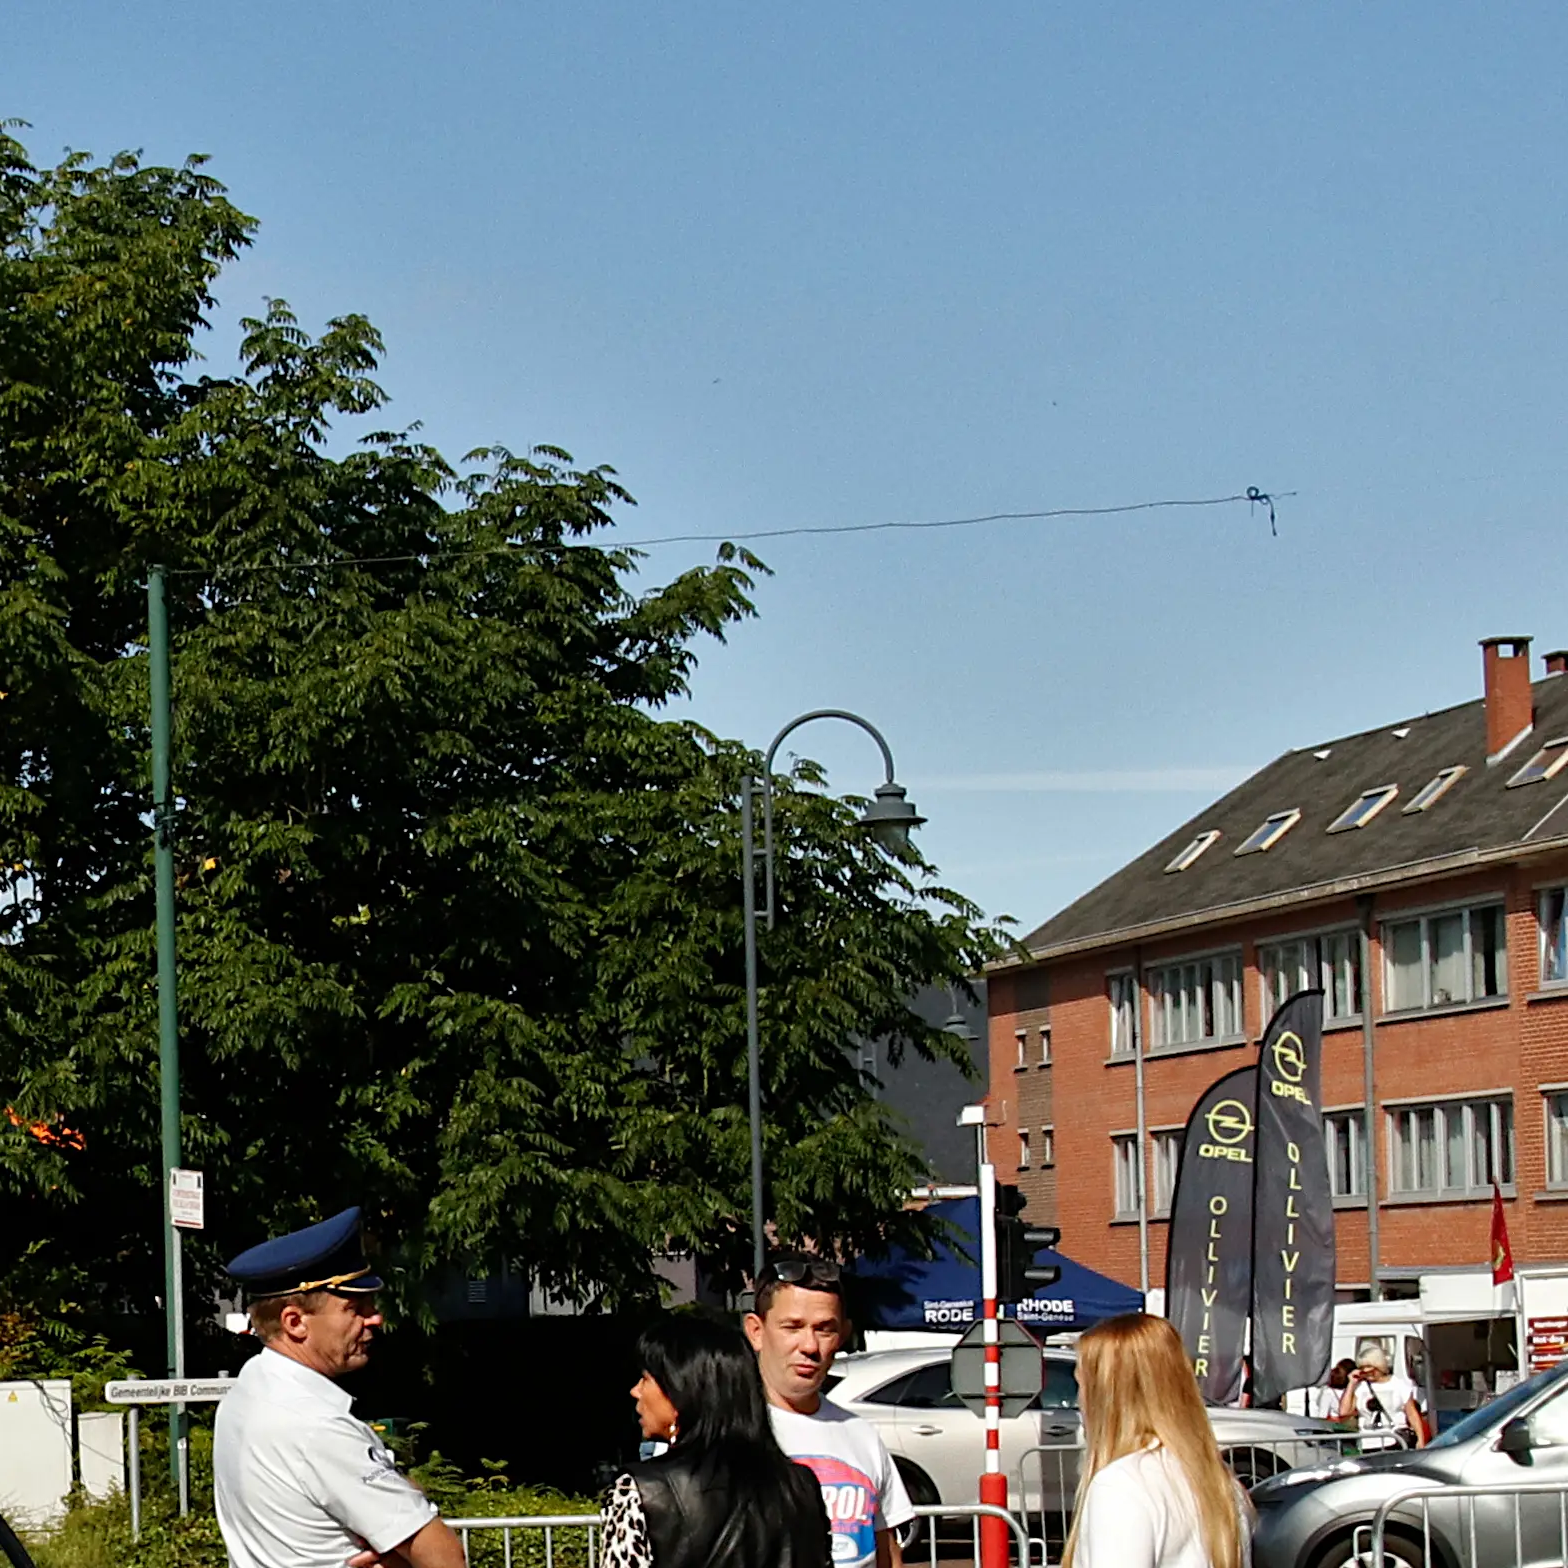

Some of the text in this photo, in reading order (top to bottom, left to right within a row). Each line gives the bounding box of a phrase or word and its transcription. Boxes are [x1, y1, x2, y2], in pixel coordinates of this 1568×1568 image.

[1271, 1079, 1313, 1106] OPEL
[1198, 1142, 1253, 1164] OPEL
[1281, 1141, 1303, 1355] OLLIVIER
[1195, 1195, 1228, 1378] OLLIVIER
[924, 1307, 974, 1323] RODE
[1016, 1297, 1074, 1314] RHODE
[110, 1384, 233, 1400] Gemeentelijke BIB Commun
